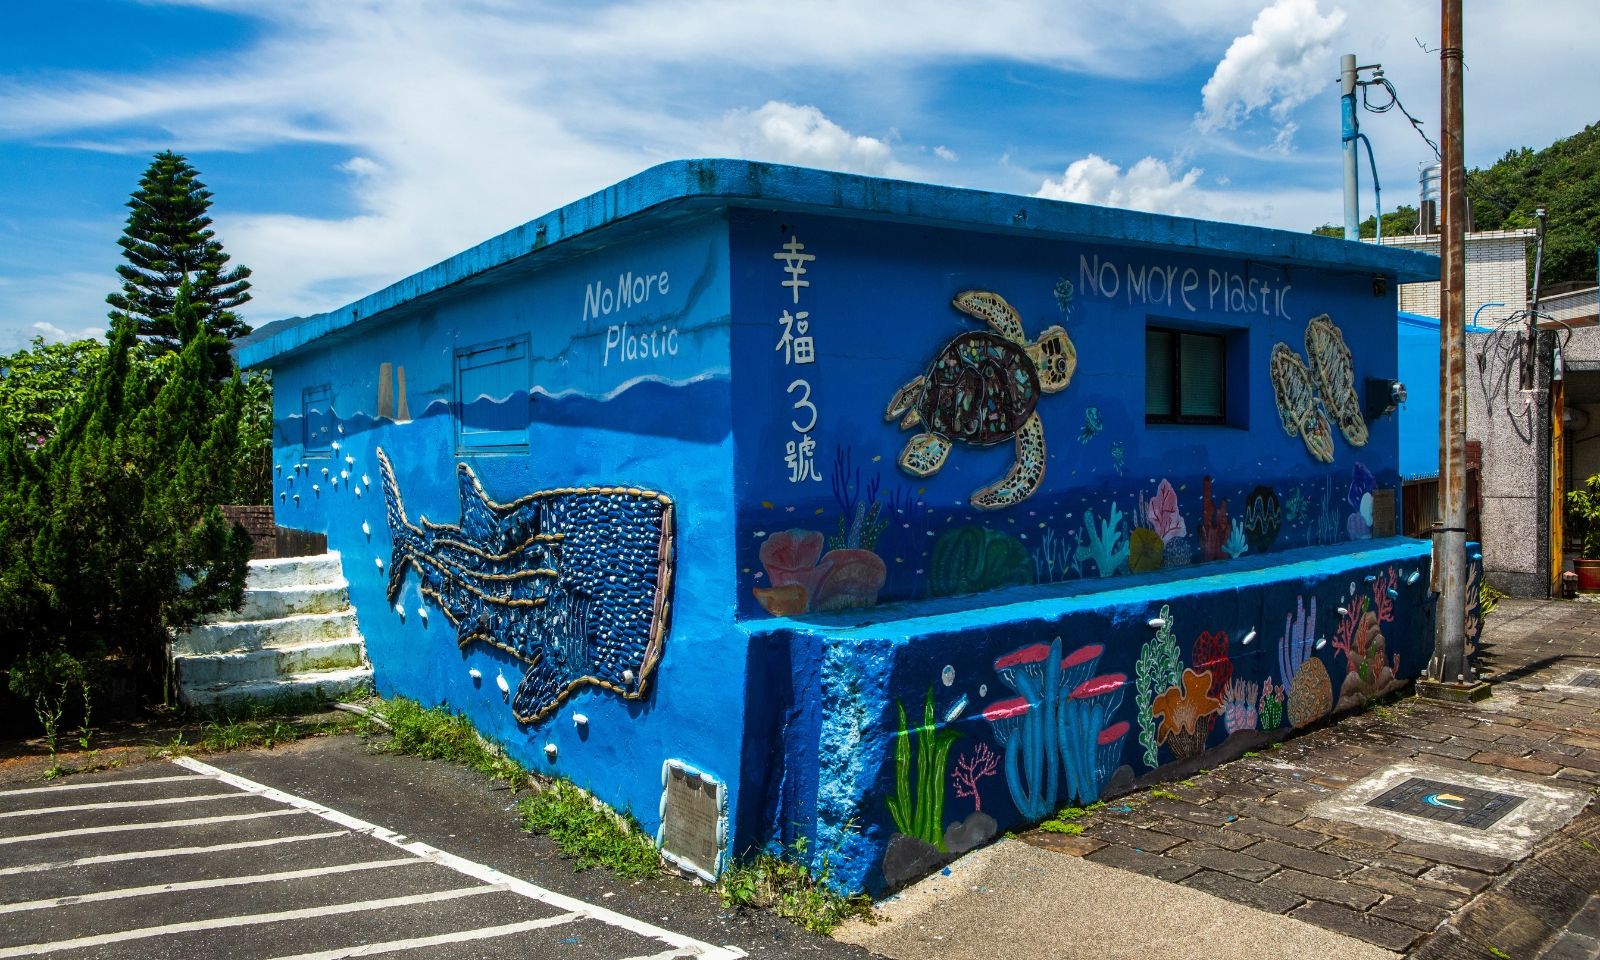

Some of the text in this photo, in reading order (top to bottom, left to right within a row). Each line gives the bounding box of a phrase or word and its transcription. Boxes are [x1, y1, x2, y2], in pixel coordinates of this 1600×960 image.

[583, 271, 669, 321] No More
[1208, 268, 1292, 321] Plastic
[604, 321, 678, 366] Plastic
[773, 235, 823, 482] 幸福3號
